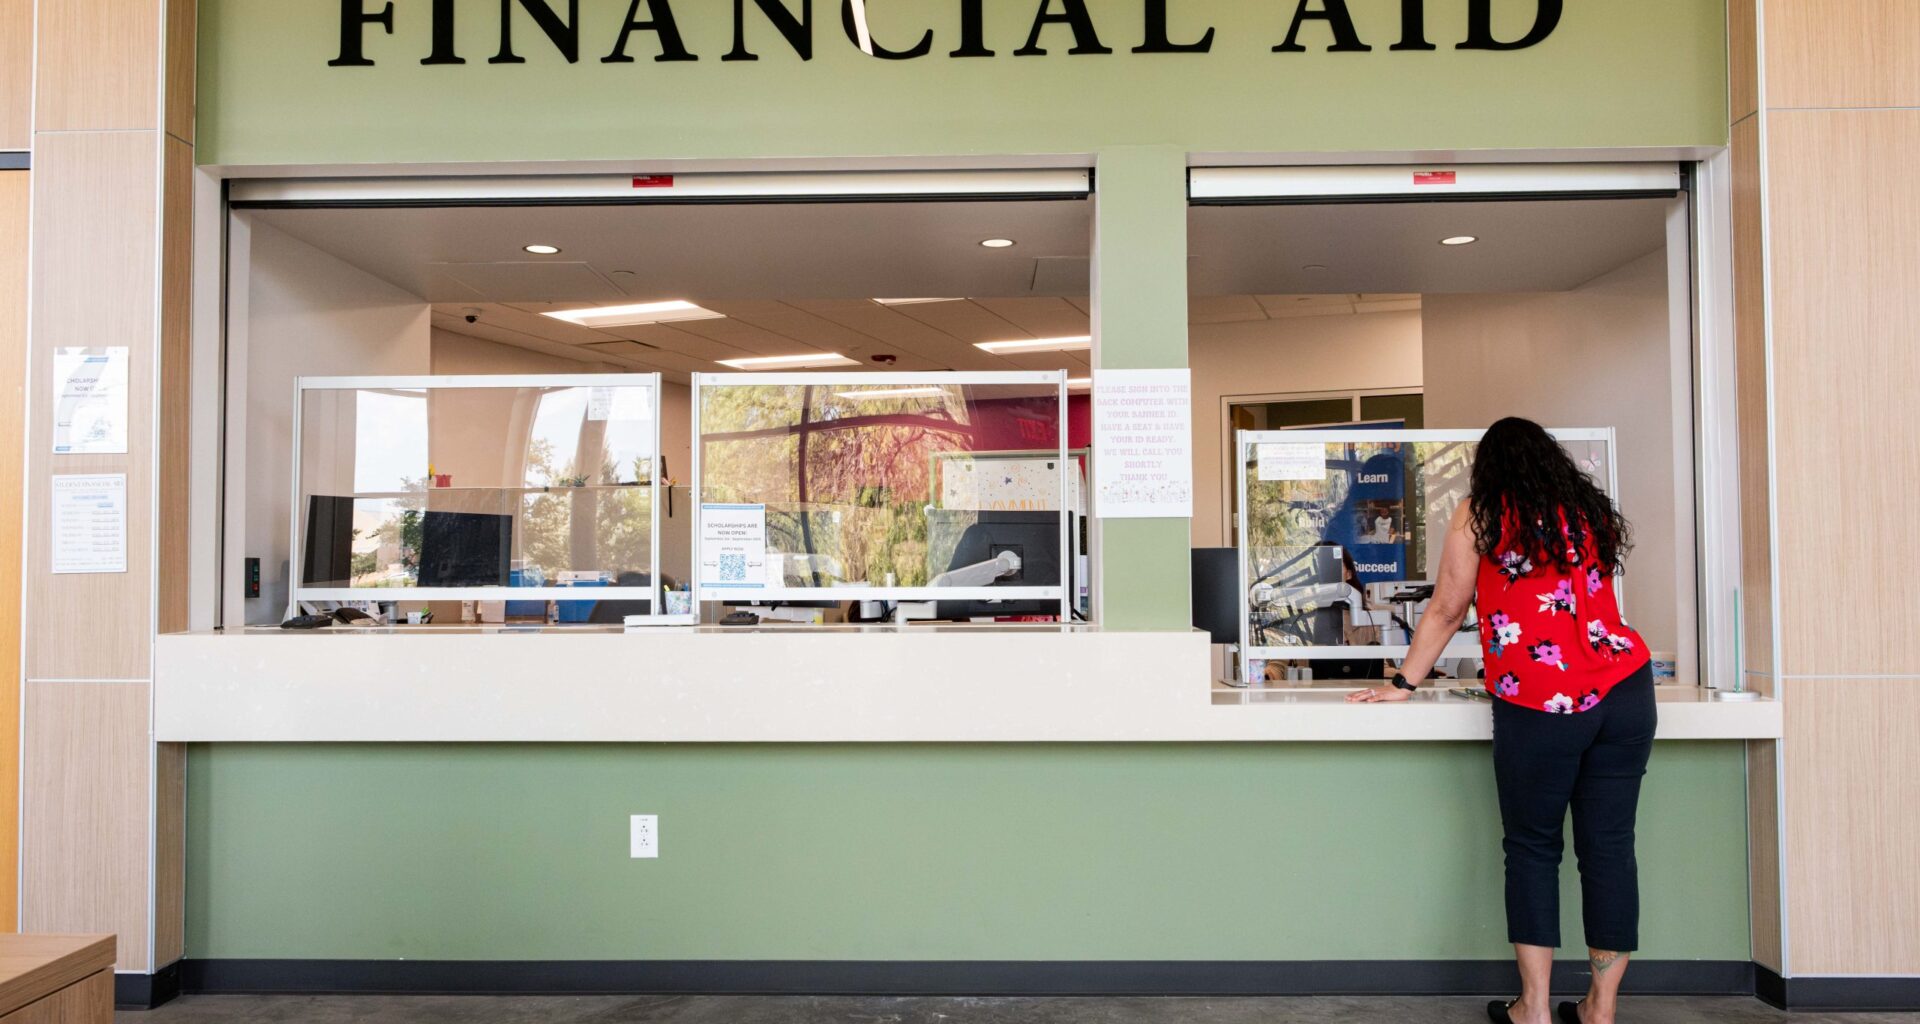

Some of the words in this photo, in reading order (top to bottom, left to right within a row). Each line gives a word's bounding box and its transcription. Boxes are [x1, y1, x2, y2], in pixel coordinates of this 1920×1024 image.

[328, 0, 1215, 67] FINANCIAL
[1272, 0, 1564, 53] AID
[1120, 398, 1164, 406] COMPUTER
[1110, 435, 1133, 443] YOUR
[1104, 448, 1117, 456] WE
[1119, 448, 1140, 456] WILL
[1142, 448, 1163, 456] CALL
[1164, 448, 1183, 456] YOU
[1119, 473, 1148, 481] THANK
[1149, 473, 1168, 481] YOU
[1357, 472, 1389, 484] Learn
